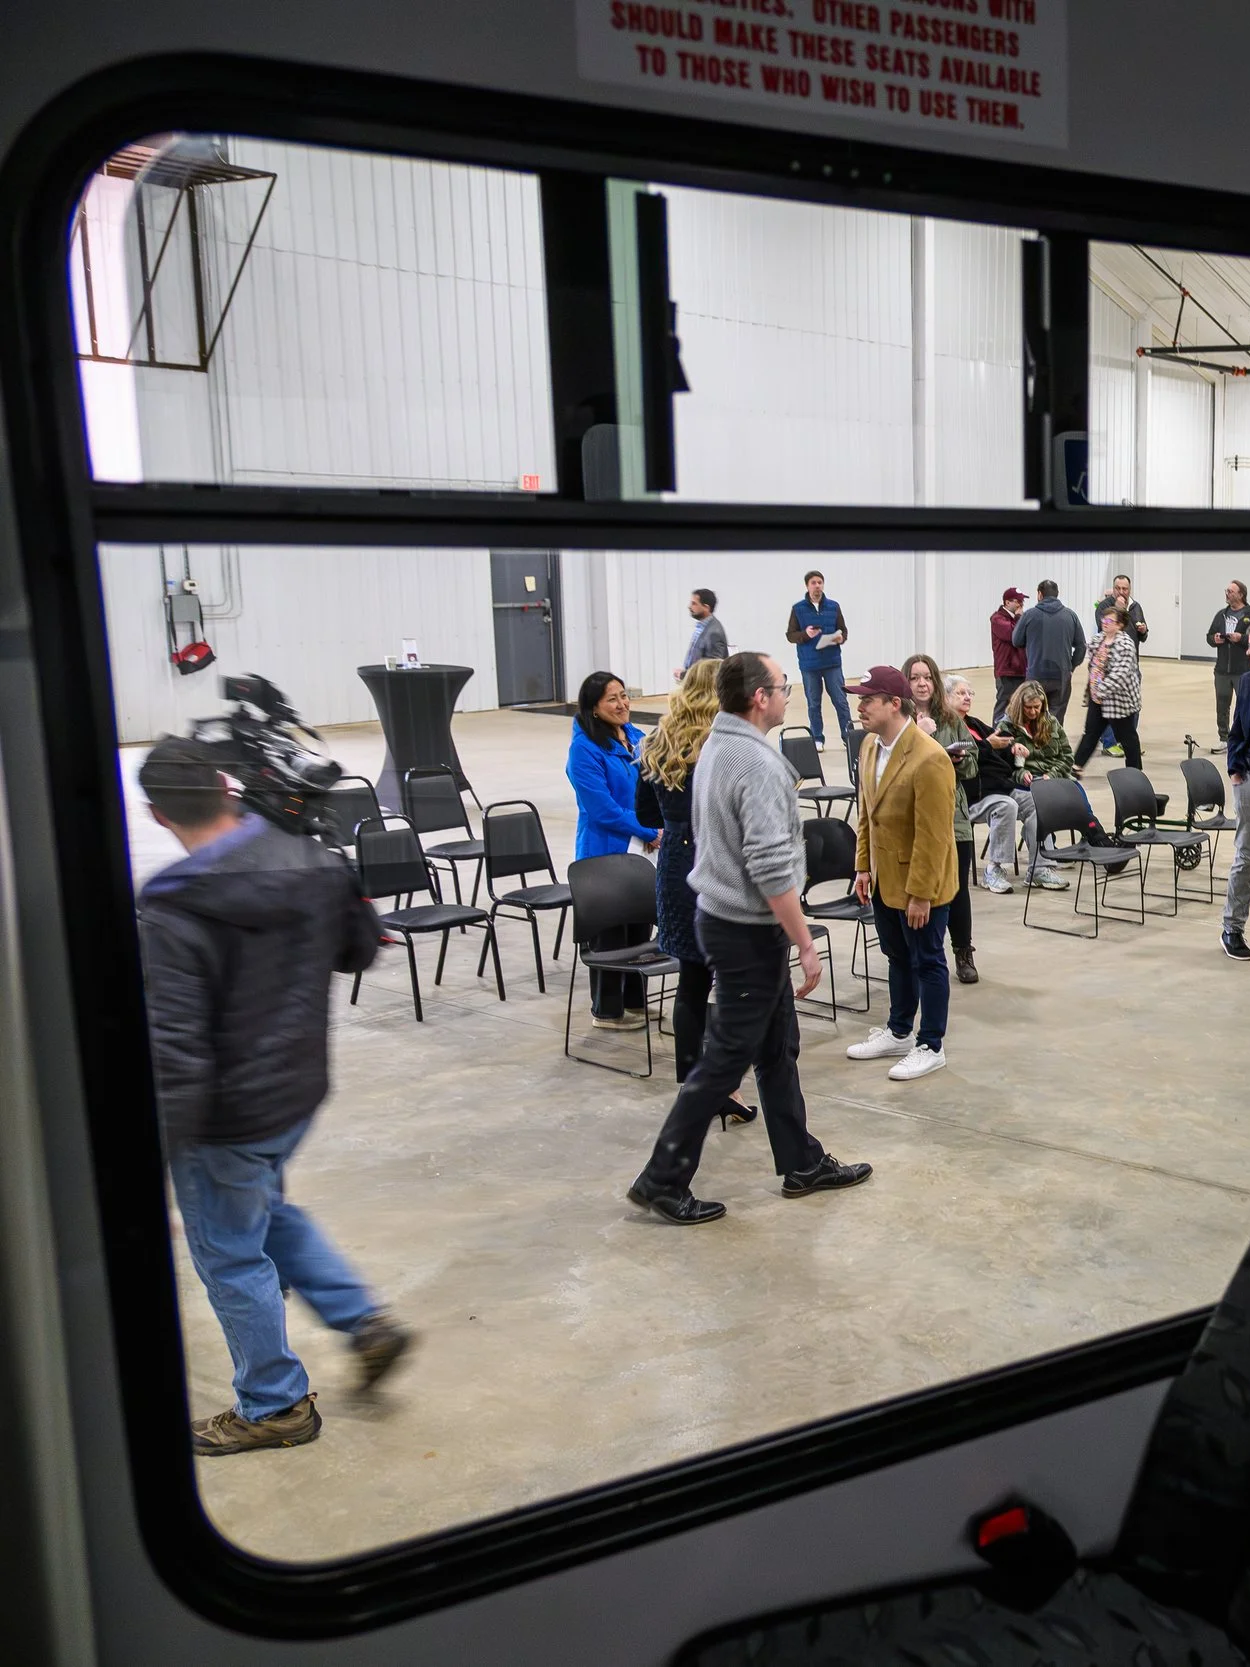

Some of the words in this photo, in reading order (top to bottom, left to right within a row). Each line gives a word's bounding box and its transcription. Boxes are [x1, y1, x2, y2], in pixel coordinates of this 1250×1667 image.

[812, 0, 880, 34] OTHER
[890, 10, 1020, 58] PASSENGERS
[988, 0, 1036, 24] WITH
[611, 2, 702, 41] SHOULD
[714, 19, 778, 54] MAKE
[788, 31, 855, 67] THESE
[866, 45, 930, 79] SEATS
[940, 57, 1041, 97] AVAILABLE
[637, 44, 667, 77] TO
[678, 51, 751, 89] THOSE
[761, 66, 811, 98] WHO
[820, 75, 877, 108] WISH
[887, 85, 911, 113] TO
[919, 91, 957, 120] USE
[967, 98, 1025, 130] THEM.
